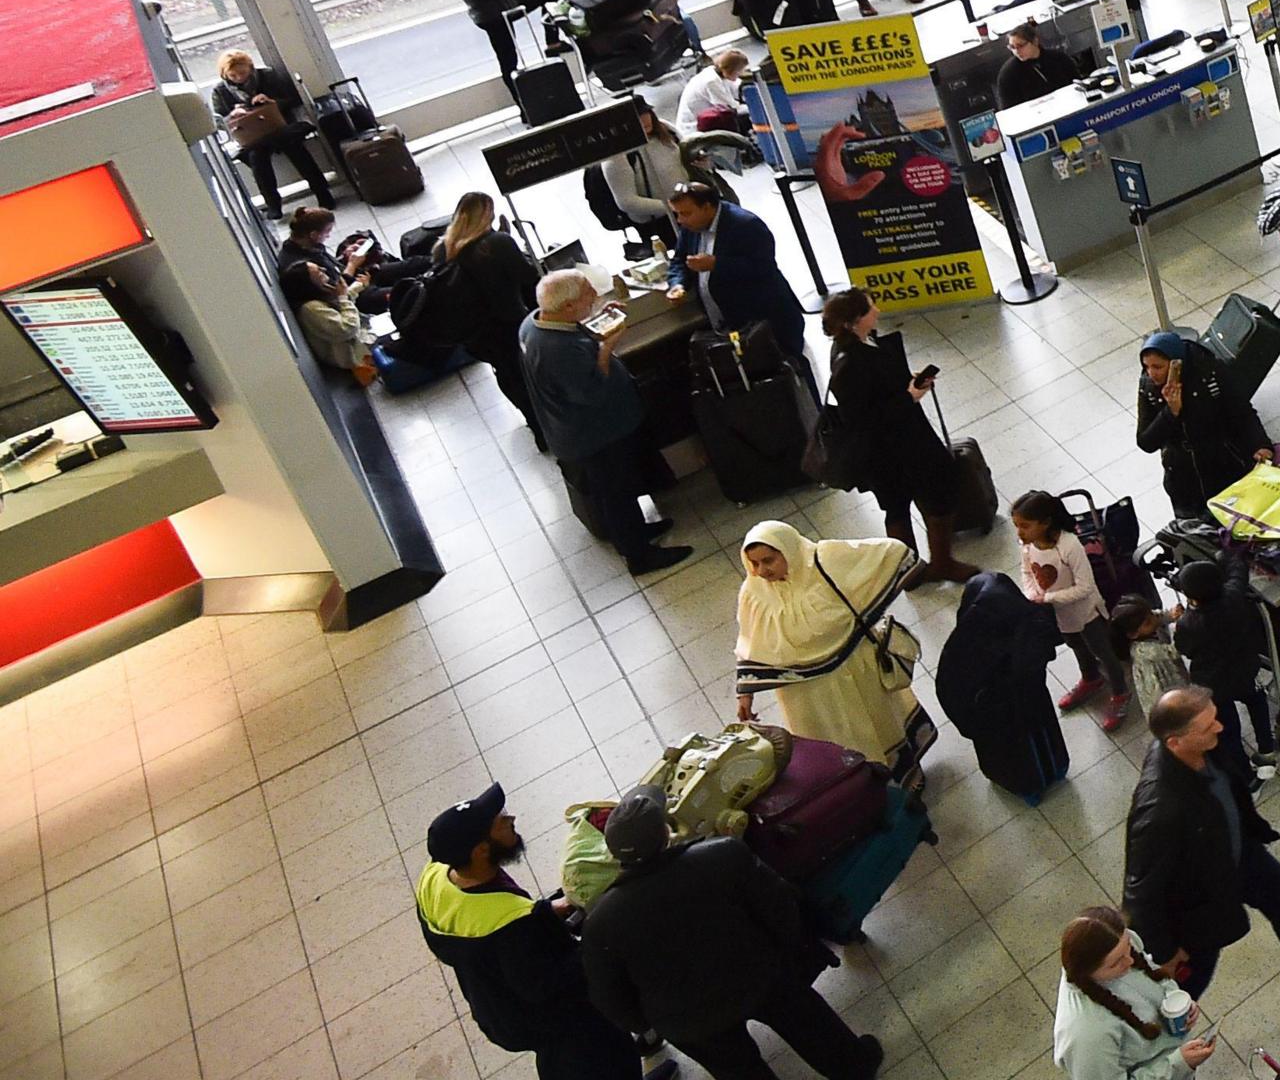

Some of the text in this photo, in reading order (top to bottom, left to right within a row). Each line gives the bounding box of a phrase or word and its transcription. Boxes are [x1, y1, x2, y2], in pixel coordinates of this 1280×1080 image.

[780, 40, 845, 63] SAVE
[786, 47, 915, 74] ON ATTRACTIONS
[790, 73, 818, 84] WITH
[820, 70, 838, 81] THE
[841, 63, 885, 78] LONDON
[1083, 82, 1182, 128] TRANSPORT FOR LONDON
[853, 150, 897, 165] LONDON
[868, 159, 892, 169] PASS
[879, 206, 900, 216] entry
[865, 260, 972, 288] BUY YOUR
[869, 276, 978, 304] PASS HERE
